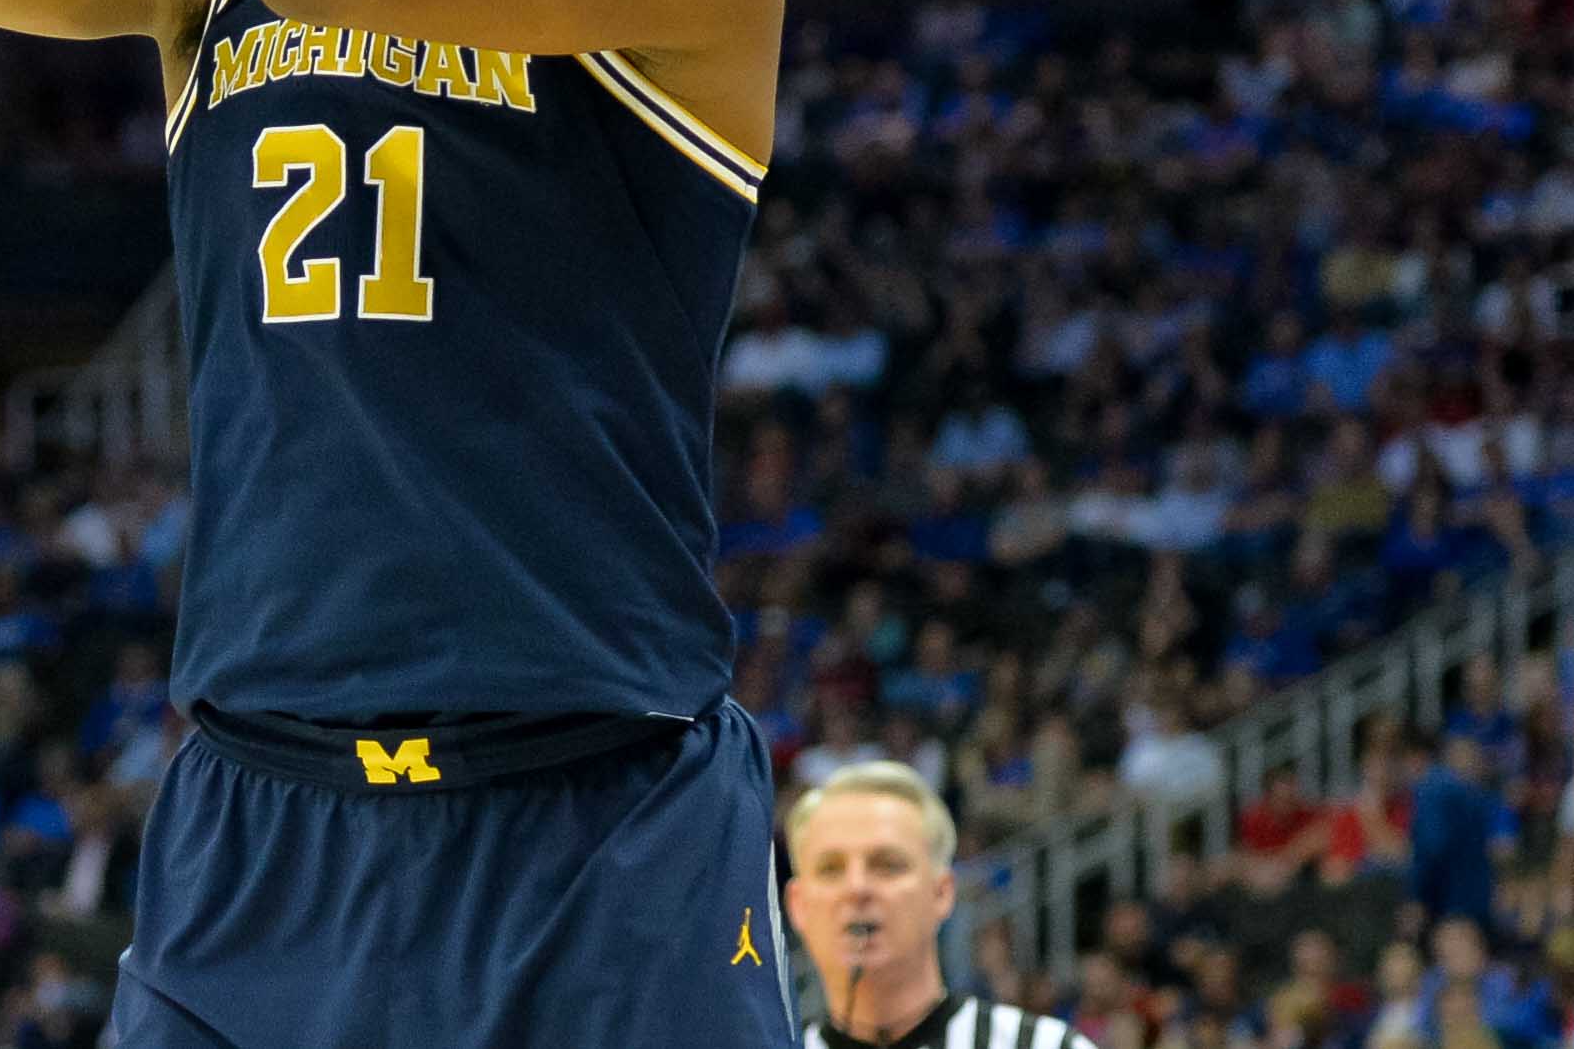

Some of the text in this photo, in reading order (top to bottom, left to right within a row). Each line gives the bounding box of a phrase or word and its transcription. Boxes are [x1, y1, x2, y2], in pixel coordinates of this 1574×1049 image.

[208, 18, 537, 113] MICHIGAN
[253, 124, 434, 324] 21
[355, 737, 441, 785] M
